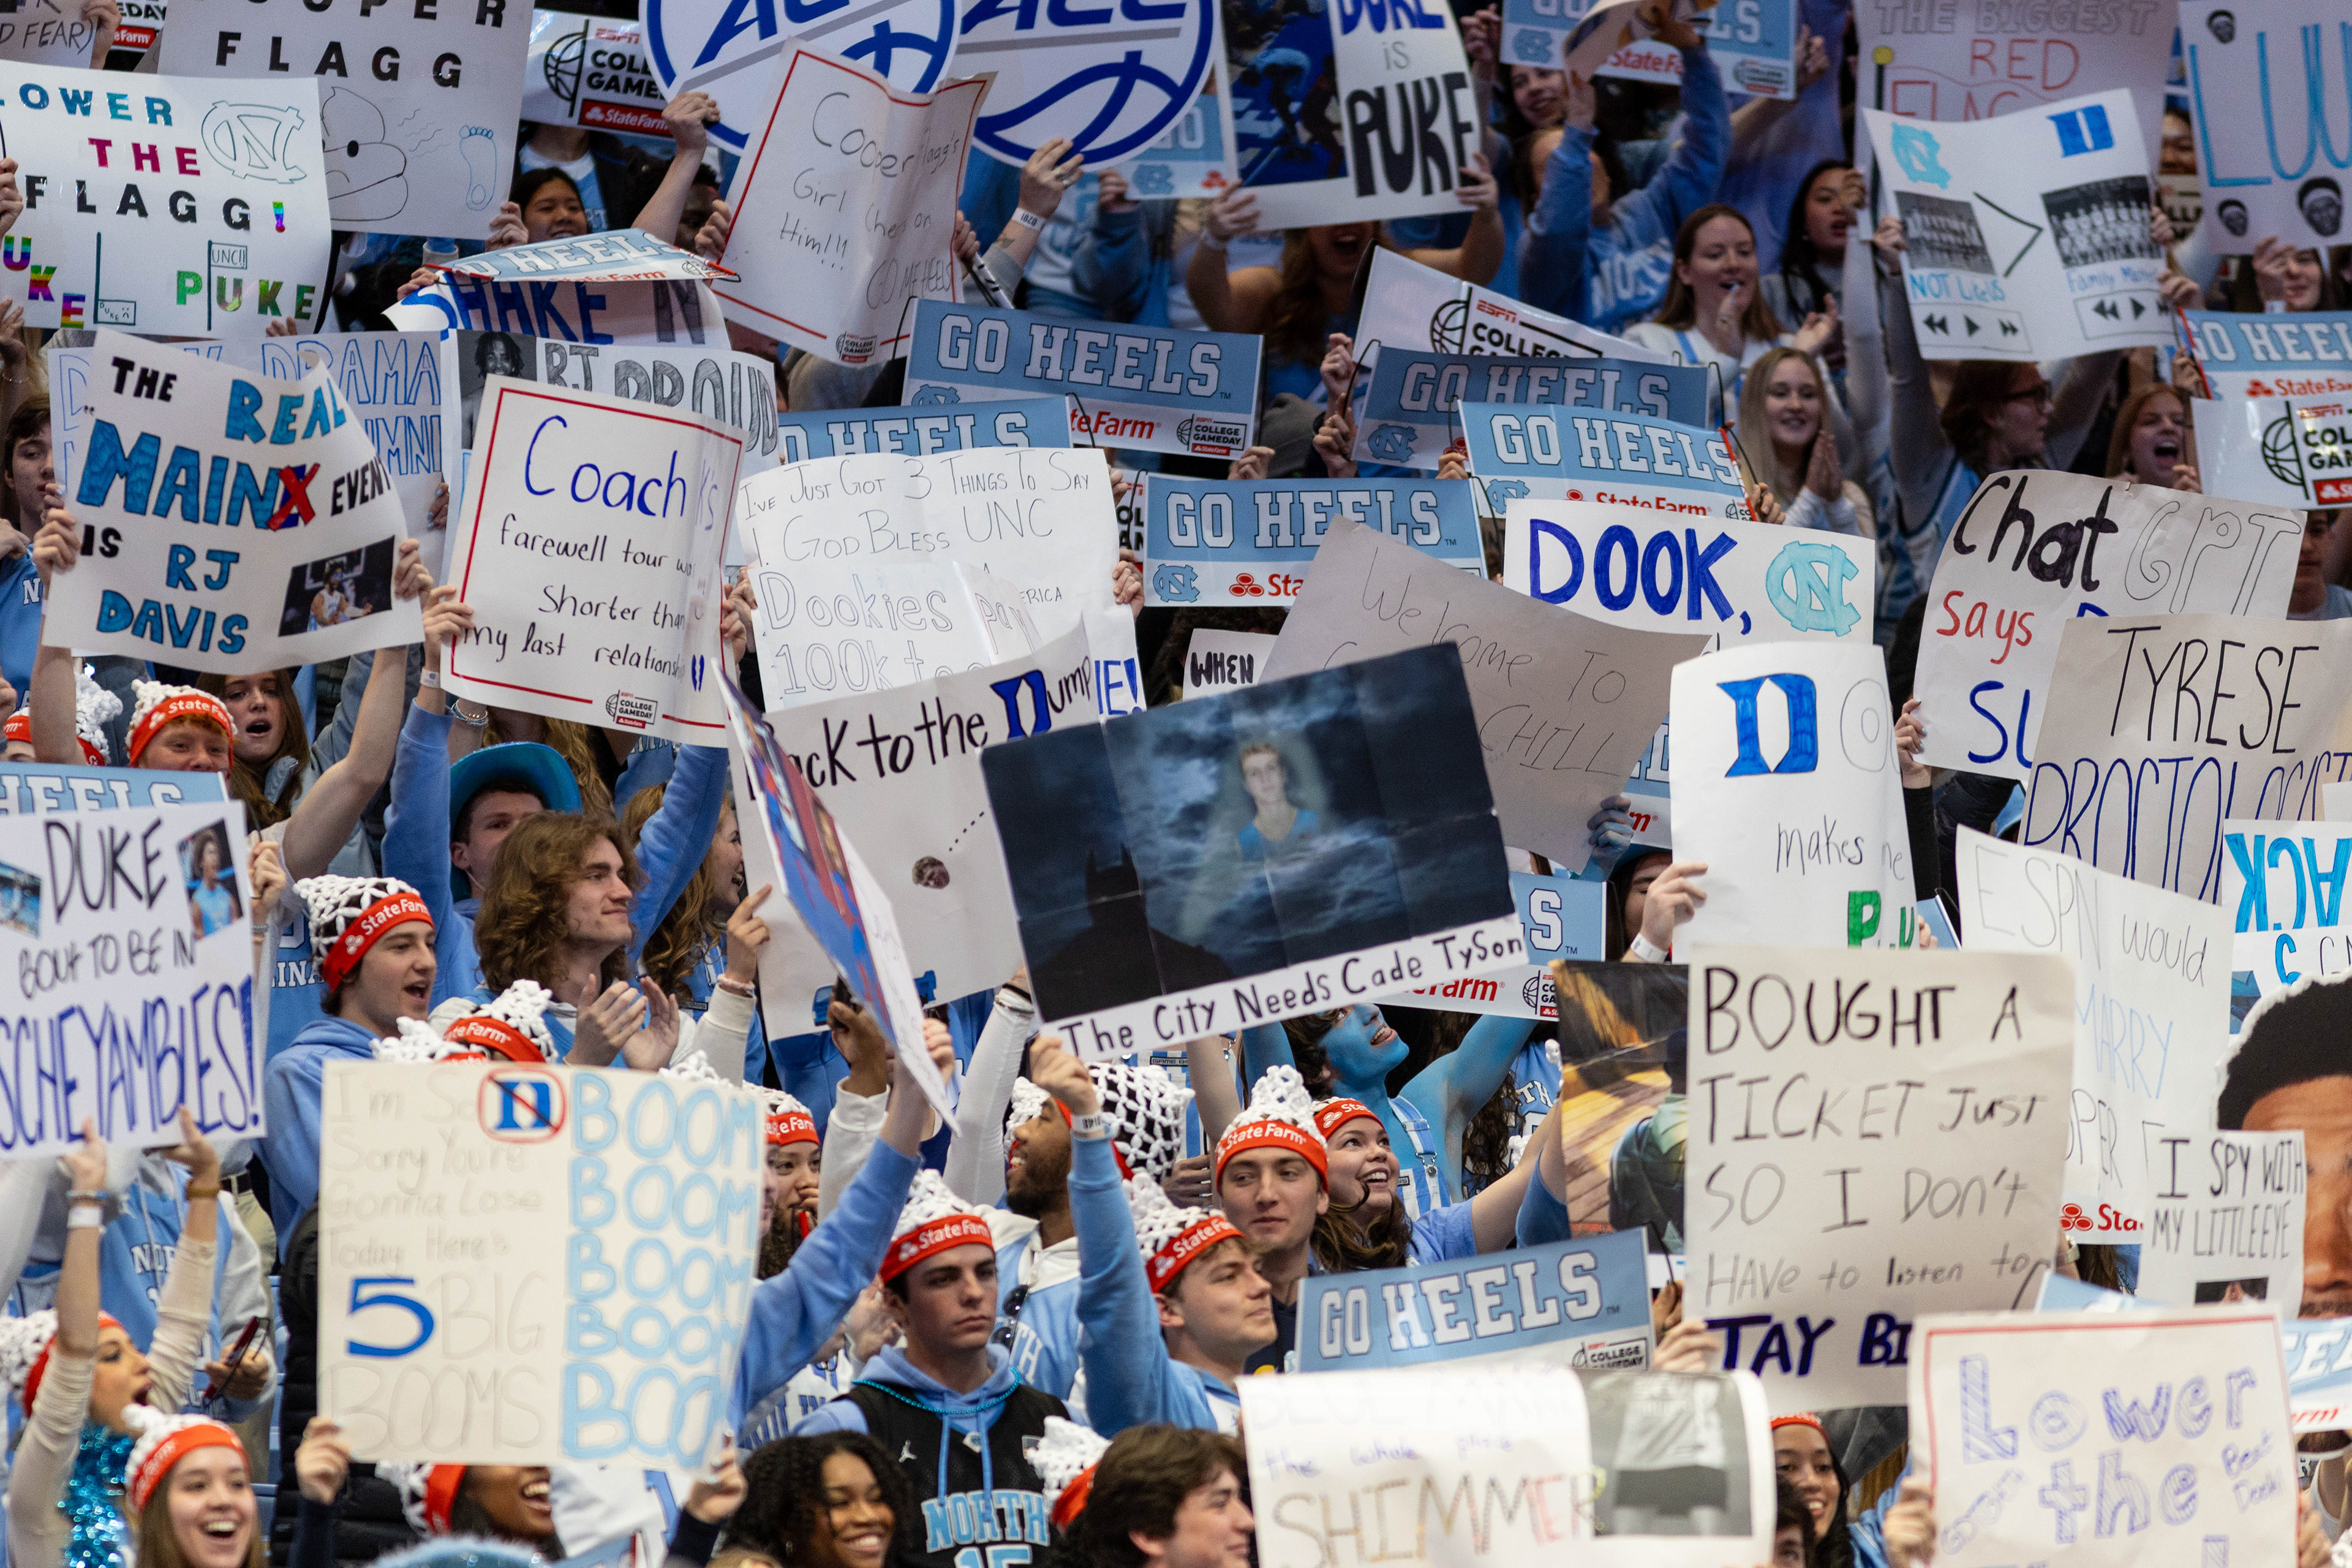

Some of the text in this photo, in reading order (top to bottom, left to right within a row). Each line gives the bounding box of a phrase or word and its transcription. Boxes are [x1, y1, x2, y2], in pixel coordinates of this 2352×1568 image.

[23, 20, 93, 55] FEAR)
[216, 31, 462, 88] FLAGG
[1970, 39, 2081, 91] RED
[88, 137, 201, 176] THE
[1346, 72, 1473, 197] PUKE
[793, 167, 846, 212] Girl
[176, 270, 316, 320] PUKE
[1476, 299, 1517, 323] ESPN
[1909, 273, 1950, 299] NOT
[937, 312, 1011, 374] GO
[1023, 322, 1221, 398] HEELS
[111, 356, 177, 402] THE
[225, 378, 347, 445] REAL
[1398, 361, 1670, 418] GO HEELS
[827, 412, 1031, 460] HEELS
[1193, 433, 1241, 445] GAMEDAY
[1194, 424, 1240, 436] COLLEGE
[1489, 413, 1743, 488] GO HEELS
[524, 415, 687, 519] Coach
[739, 480, 777, 521] I'VE
[784, 464, 832, 505] JUST
[839, 459, 886, 496] GOT
[903, 458, 932, 500] 3
[940, 455, 1009, 496] THINGS
[1048, 451, 1090, 491] SAY
[80, 526, 123, 559] IS
[500, 513, 668, 568] farewell tour
[783, 515, 859, 562] GOD
[859, 509, 951, 554] BLESS
[962, 498, 1054, 544] UNC
[1166, 491, 1234, 548] GO
[1253, 490, 1442, 548] HEELS
[1953, 475, 2302, 617] Chat GPT
[166, 544, 239, 592] RJ
[96, 589, 249, 655] DAVIS
[538, 584, 687, 630] Shorter than
[760, 571, 953, 632] Dookies
[521, 621, 565, 657] last
[1190, 652, 1254, 685] WHEN
[619, 707, 653, 719] GAMEDAY
[620, 699, 652, 711] COLLEGE
[2107, 625, 2320, 755] TYRESE
[856, 713, 914, 778] to
[914, 696, 989, 766] the
[1480, 704, 1624, 777] CHILL
[44, 818, 168, 922] DUKE
[1975, 843, 2102, 971] ESPN
[2122, 913, 2209, 987] would
[88, 933, 119, 974] TO
[127, 928, 162, 977] BE
[172, 928, 197, 967] IN
[1058, 1019, 1134, 1058] The
[1152, 998, 1216, 1042] City
[1232, 973, 1332, 1024] Needs
[1341, 949, 1423, 995] Cade
[1704, 966, 2022, 1055] BOUGHT A
[569, 1071, 760, 1171] BOOM
[1697, 1072, 1926, 1145] TICKET
[327, 1125, 430, 1193] Sorry
[2156, 1137, 2192, 1199] I
[2209, 1137, 2253, 1199] SPY
[2262, 1133, 2306, 1197] WITH
[459, 1181, 543, 1213] Lose
[568, 1155, 757, 1251] BOOM
[1705, 1161, 1786, 1232] SO
[1821, 1167, 1871, 1232] I
[2151, 1207, 2186, 1254] MY
[566, 1233, 753, 1314] BOOM
[1319, 1286, 1373, 1359] GO
[1381, 1249, 1604, 1352] HEELS
[1819, 1259, 1861, 1291] to
[1887, 1257, 1964, 1287] listen
[346, 1270, 545, 1360] 5 BIG
[1705, 1313, 1836, 1378] TAY
[1590, 1346, 1640, 1363] COLLEGE
[330, 1362, 547, 1454] BOOMS
[1959, 1353, 2258, 1464] Lower
[921, 1488, 1051, 1553] NORTH
[1273, 1466, 1607, 1568] SHIMMER
[2037, 1449, 2200, 1545] the
